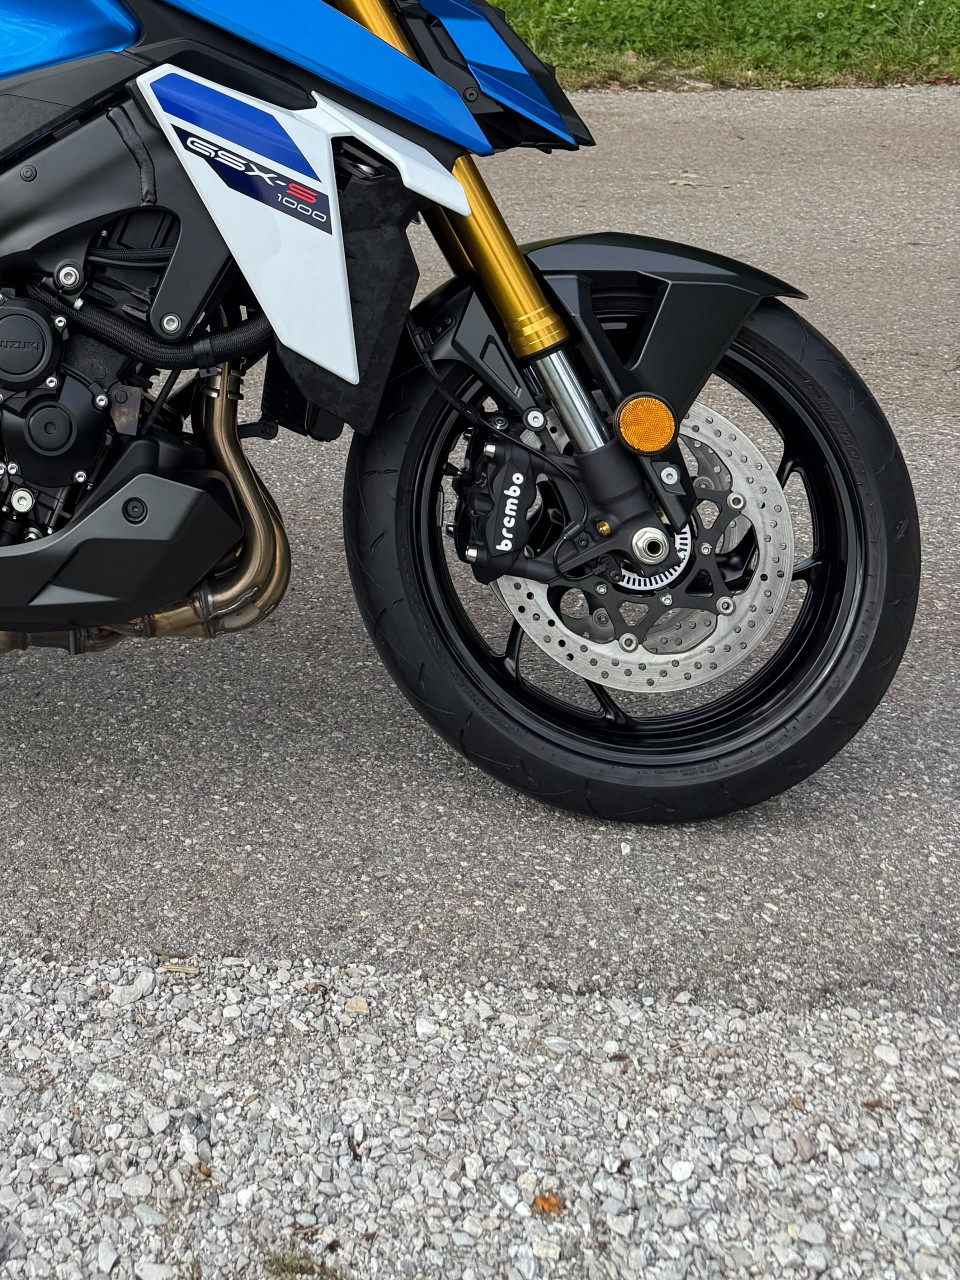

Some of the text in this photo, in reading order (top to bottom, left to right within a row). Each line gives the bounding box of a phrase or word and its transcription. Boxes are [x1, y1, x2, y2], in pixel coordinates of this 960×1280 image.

[186, 137, 318, 204] GSX-S
[277, 193, 327, 222] 1000
[496, 472, 524, 551] brembo
